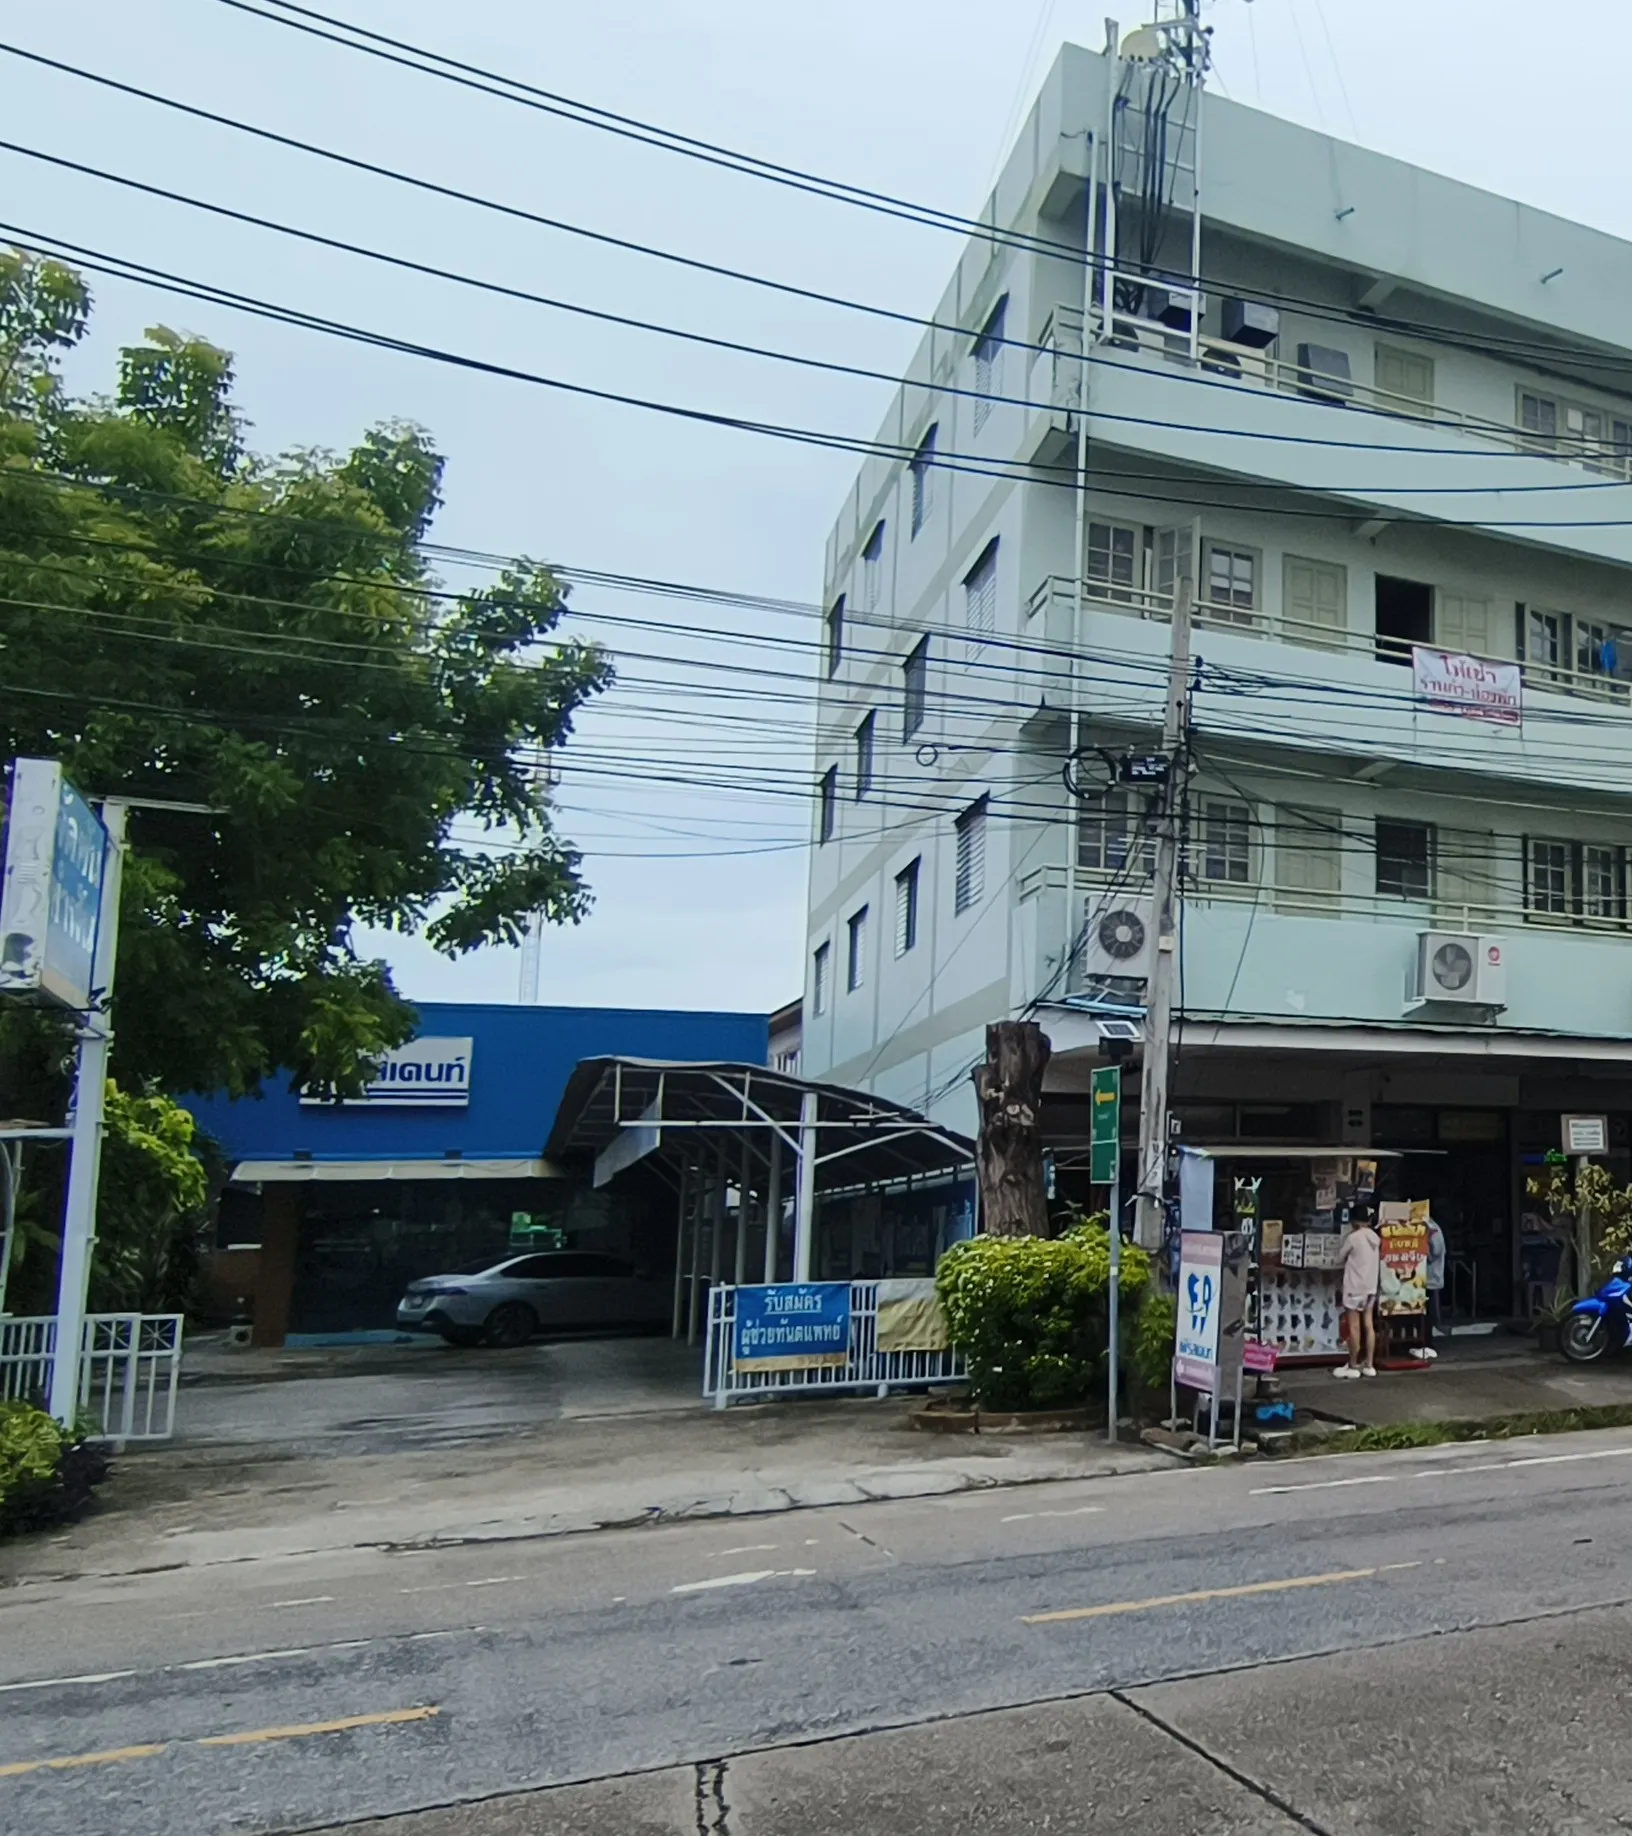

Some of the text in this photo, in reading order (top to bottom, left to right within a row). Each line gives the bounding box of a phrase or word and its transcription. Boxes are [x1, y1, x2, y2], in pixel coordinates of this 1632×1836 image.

[1440, 655, 1497, 684] ให้เช่า
[764, 1287, 822, 1311] รับสมัคร
[741, 1315, 844, 1355] ผู้ช่วยทันตแพทย์
